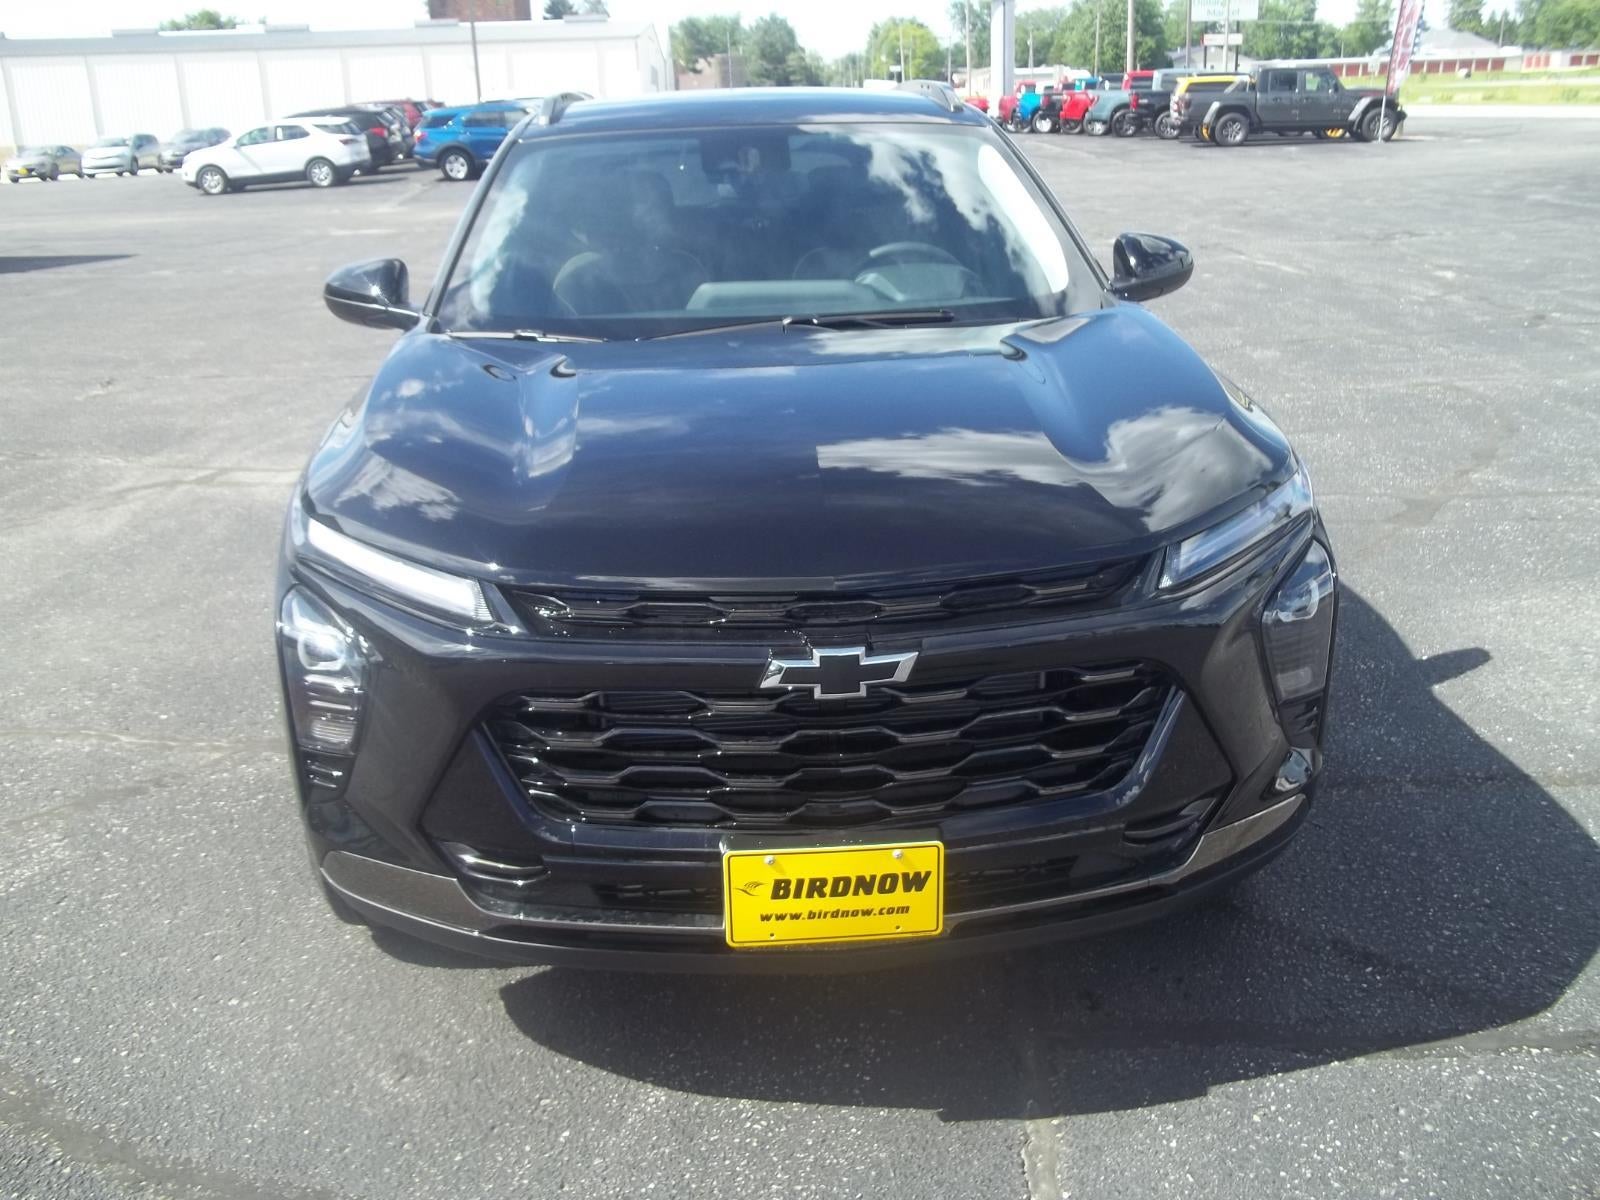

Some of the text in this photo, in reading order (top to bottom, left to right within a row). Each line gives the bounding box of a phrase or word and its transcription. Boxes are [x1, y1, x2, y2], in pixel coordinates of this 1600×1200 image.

[1207, 8, 1240, 16] Maret
[770, 870, 932, 900] BIRDNOW
[760, 905, 910, 922] www.birdnow.com
